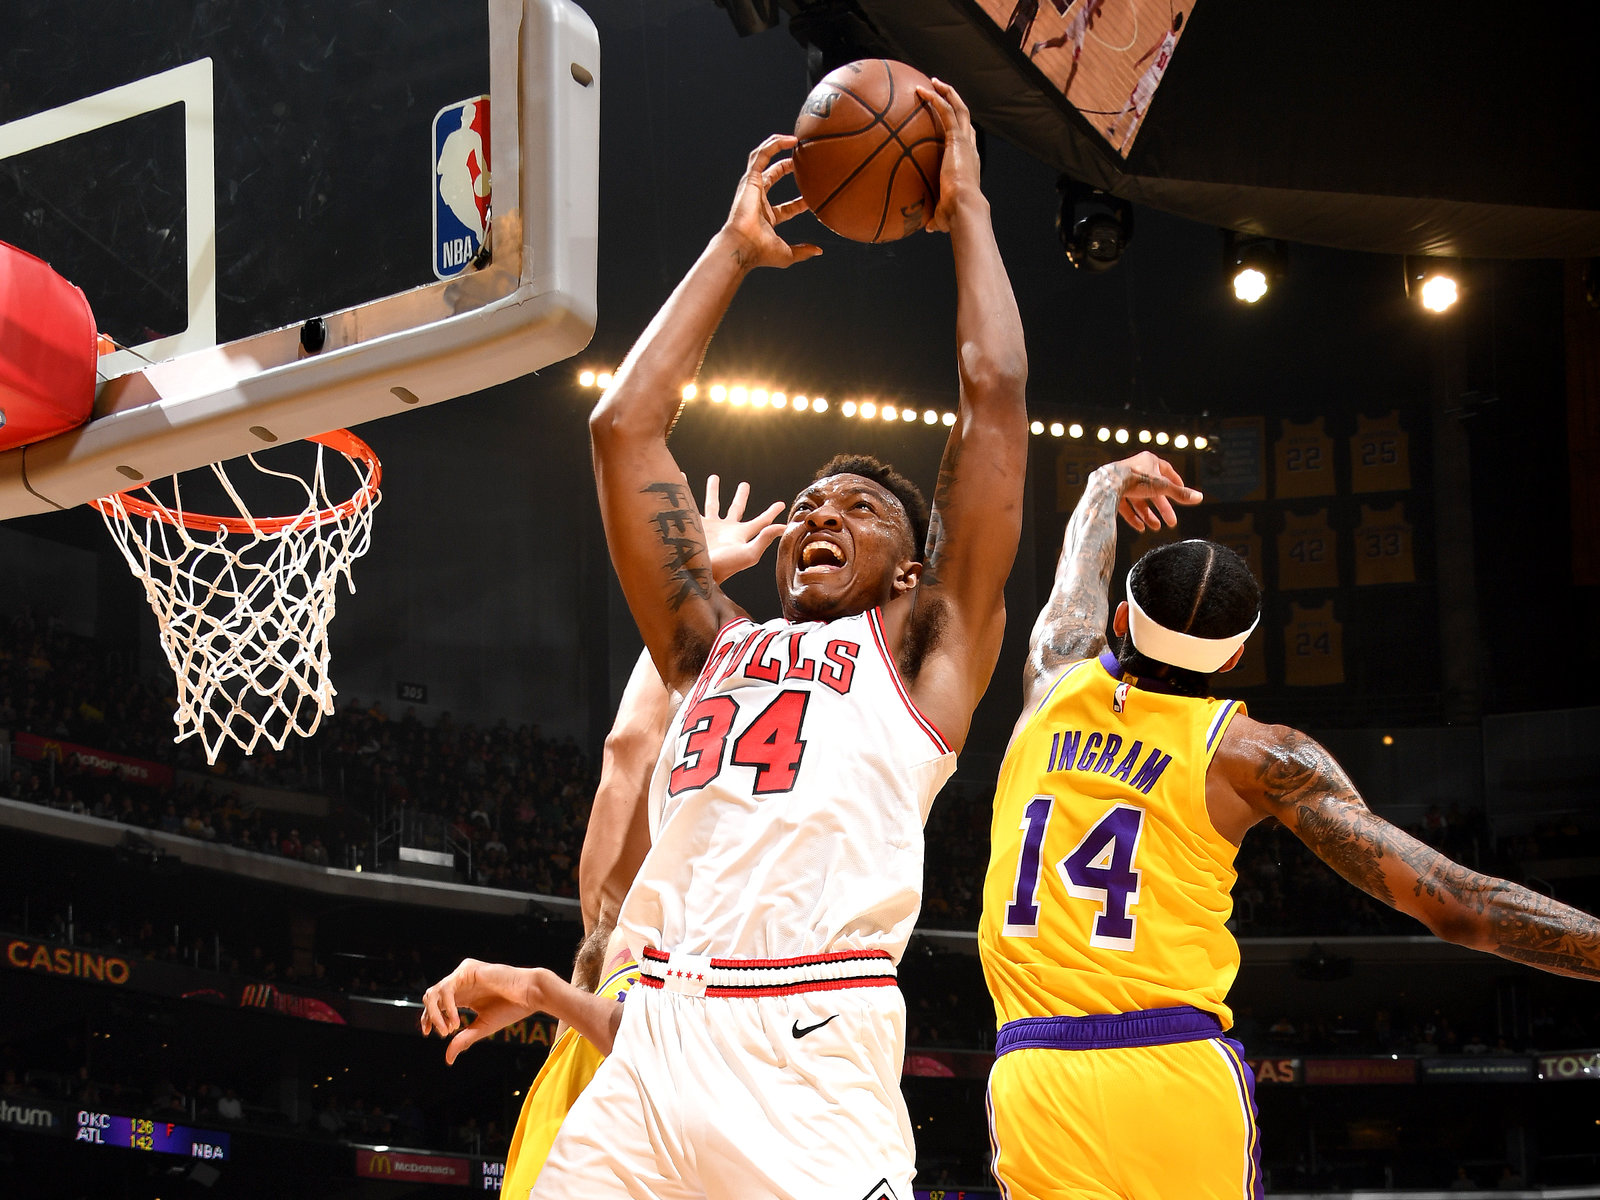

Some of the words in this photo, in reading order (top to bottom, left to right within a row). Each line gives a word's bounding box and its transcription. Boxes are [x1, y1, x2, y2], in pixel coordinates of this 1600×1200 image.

[443, 235, 473, 269] NBA
[1287, 447, 1323, 473] 22
[1361, 441, 1399, 467] 25
[639, 482, 714, 613] FEAR
[1289, 539, 1325, 563] 42
[1366, 533, 1402, 558] 33
[1295, 631, 1331, 658] 24
[681, 628, 860, 724] BULLS
[402, 685, 425, 700] 305
[668, 689, 811, 798] 34
[1047, 730, 1172, 795] INGRAM
[1001, 794, 1146, 953] 14
[7, 939, 131, 985] CASINO
[1541, 1056, 1600, 1078] TOY
[78, 1110, 111, 1129] OKC
[131, 1118, 154, 1135] 126
[166, 1123, 175, 1137] F
[75, 1127, 105, 1144] ATL
[130, 1135, 153, 1151] 142
[192, 1142, 224, 1160] NBA
[394, 1162, 456, 1176] McDonald's
